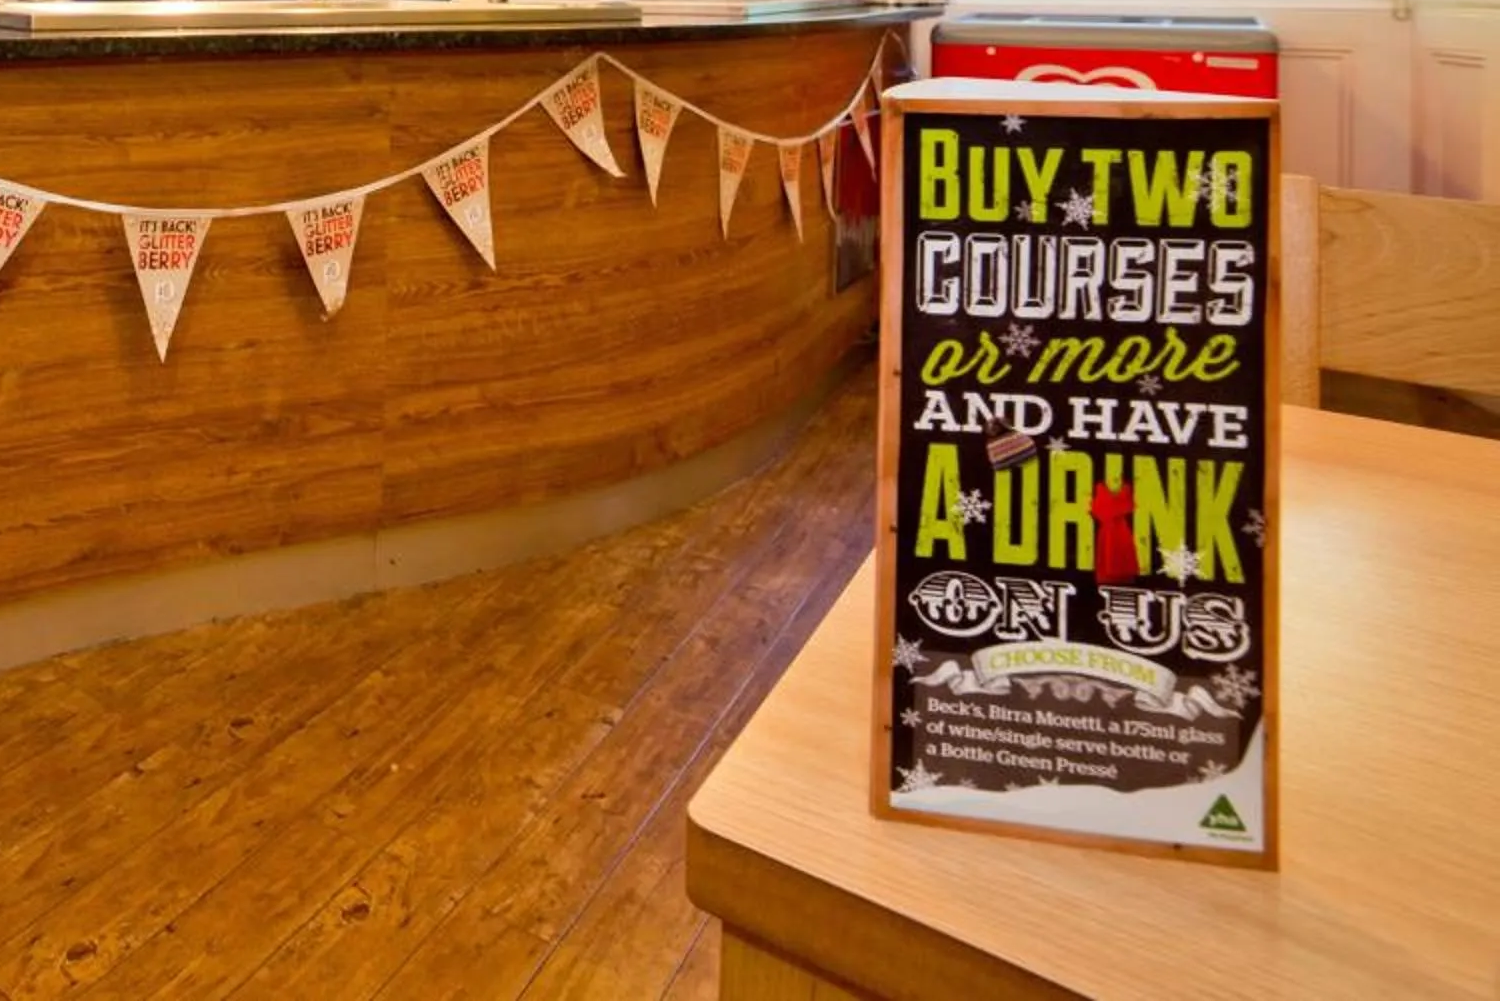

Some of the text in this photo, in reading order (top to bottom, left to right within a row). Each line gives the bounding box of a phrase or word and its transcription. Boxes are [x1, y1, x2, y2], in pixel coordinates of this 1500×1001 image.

[919, 128, 1253, 229] BUY TWO
[138, 250, 194, 270] BERRY
[139, 233, 196, 249] GLITTER
[306, 230, 353, 256] BERRY
[916, 230, 1255, 326] COURSES
[921, 327, 1241, 385] or more
[913, 390, 1249, 449] AND HAVE
[914, 442, 967, 561] A
[908, 570, 1251, 662] ON US
[988, 647, 1157, 685] CHOOSE FROM
[925, 720, 1192, 765] of wine/single serve bottle or
[927, 698, 986, 719] Beck's,
[989, 703, 1033, 724] Birra
[1108, 721, 1121, 734] a
[1123, 719, 1176, 740] 175ml
[1178, 726, 1225, 746] glass
[925, 742, 1119, 779] a Bottle Green Pressé
